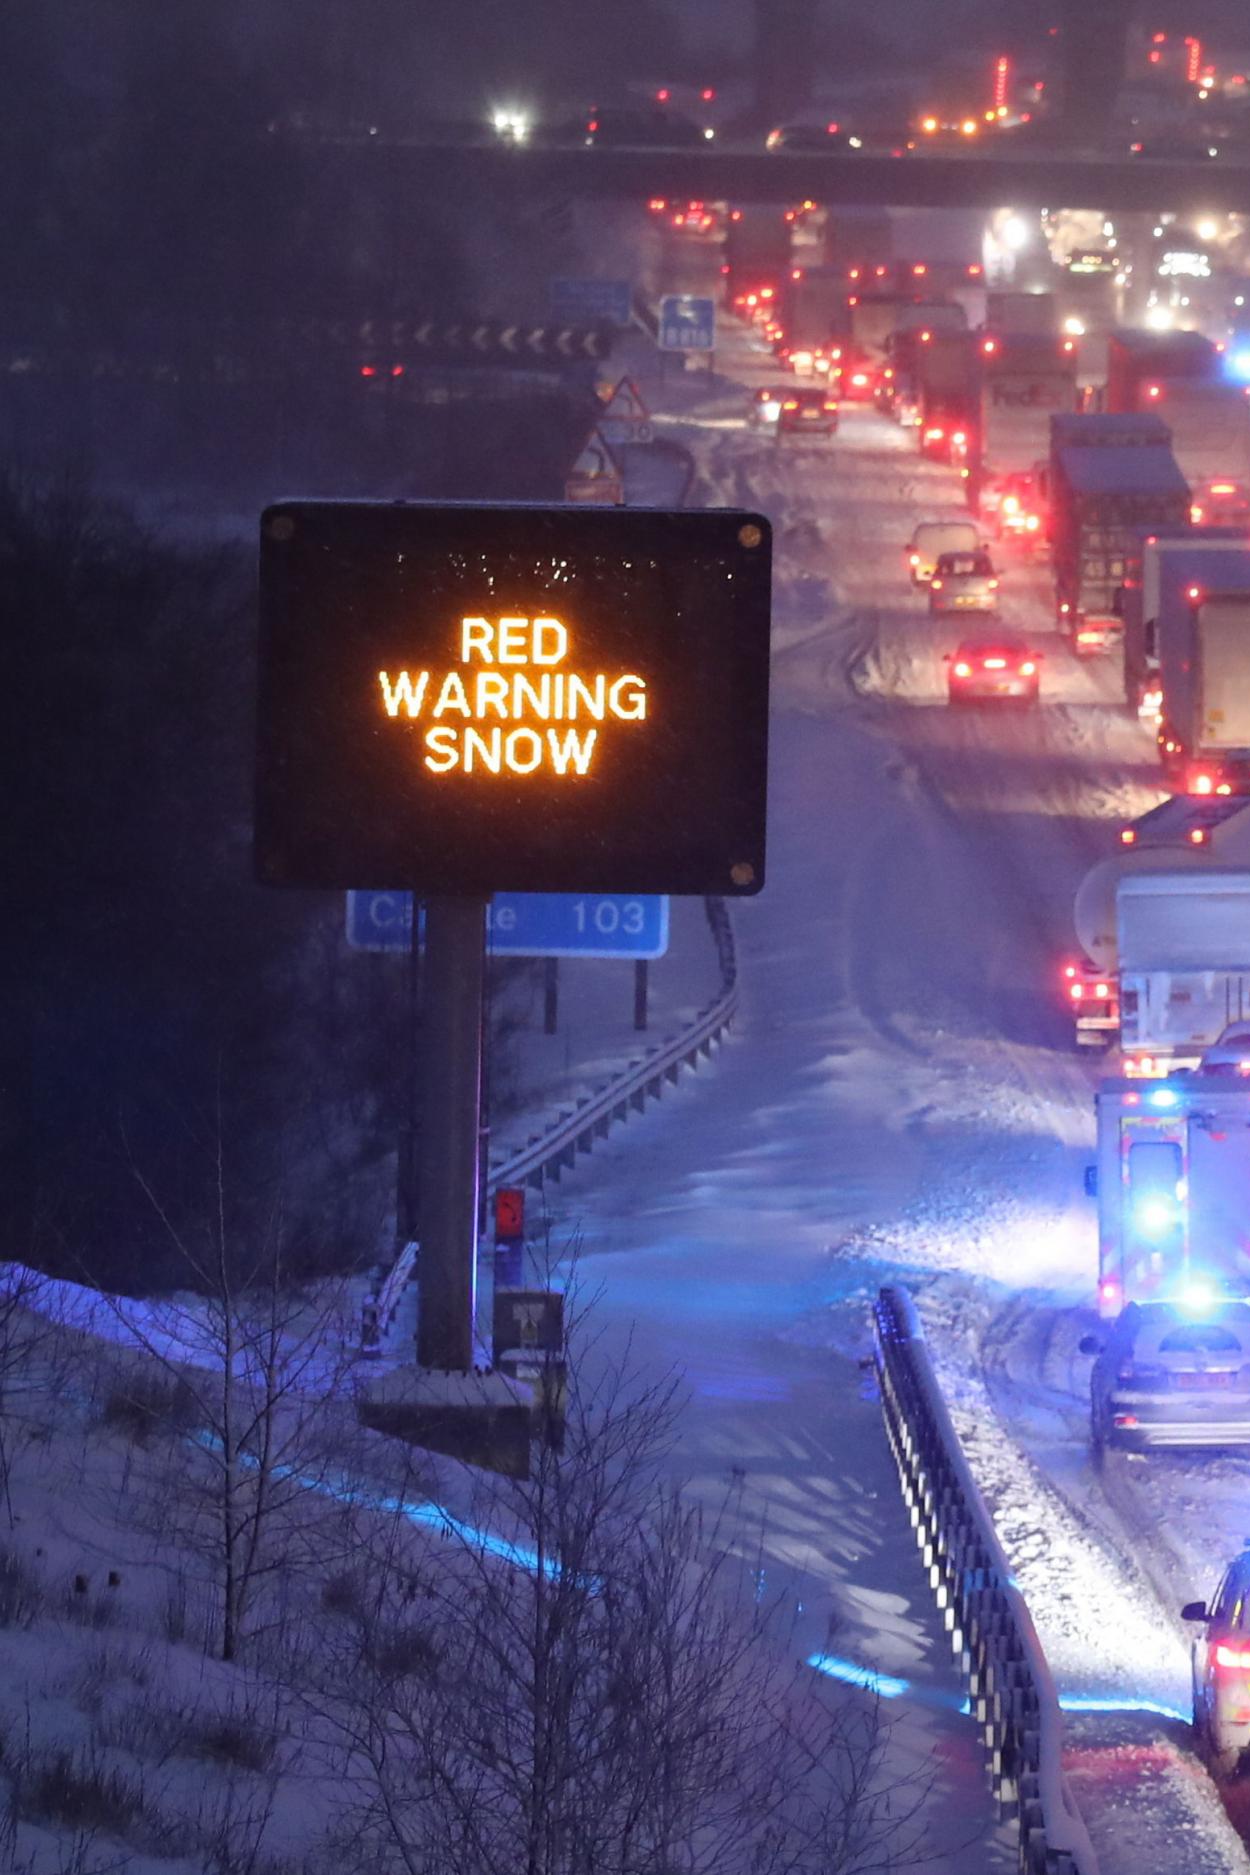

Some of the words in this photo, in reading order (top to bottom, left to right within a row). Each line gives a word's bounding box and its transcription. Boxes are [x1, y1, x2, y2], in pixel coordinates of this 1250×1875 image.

[460, 616, 569, 666] RED
[378, 671, 647, 721] WARNING
[423, 726, 597, 776] SNOW
[572, 901, 646, 935] 103
